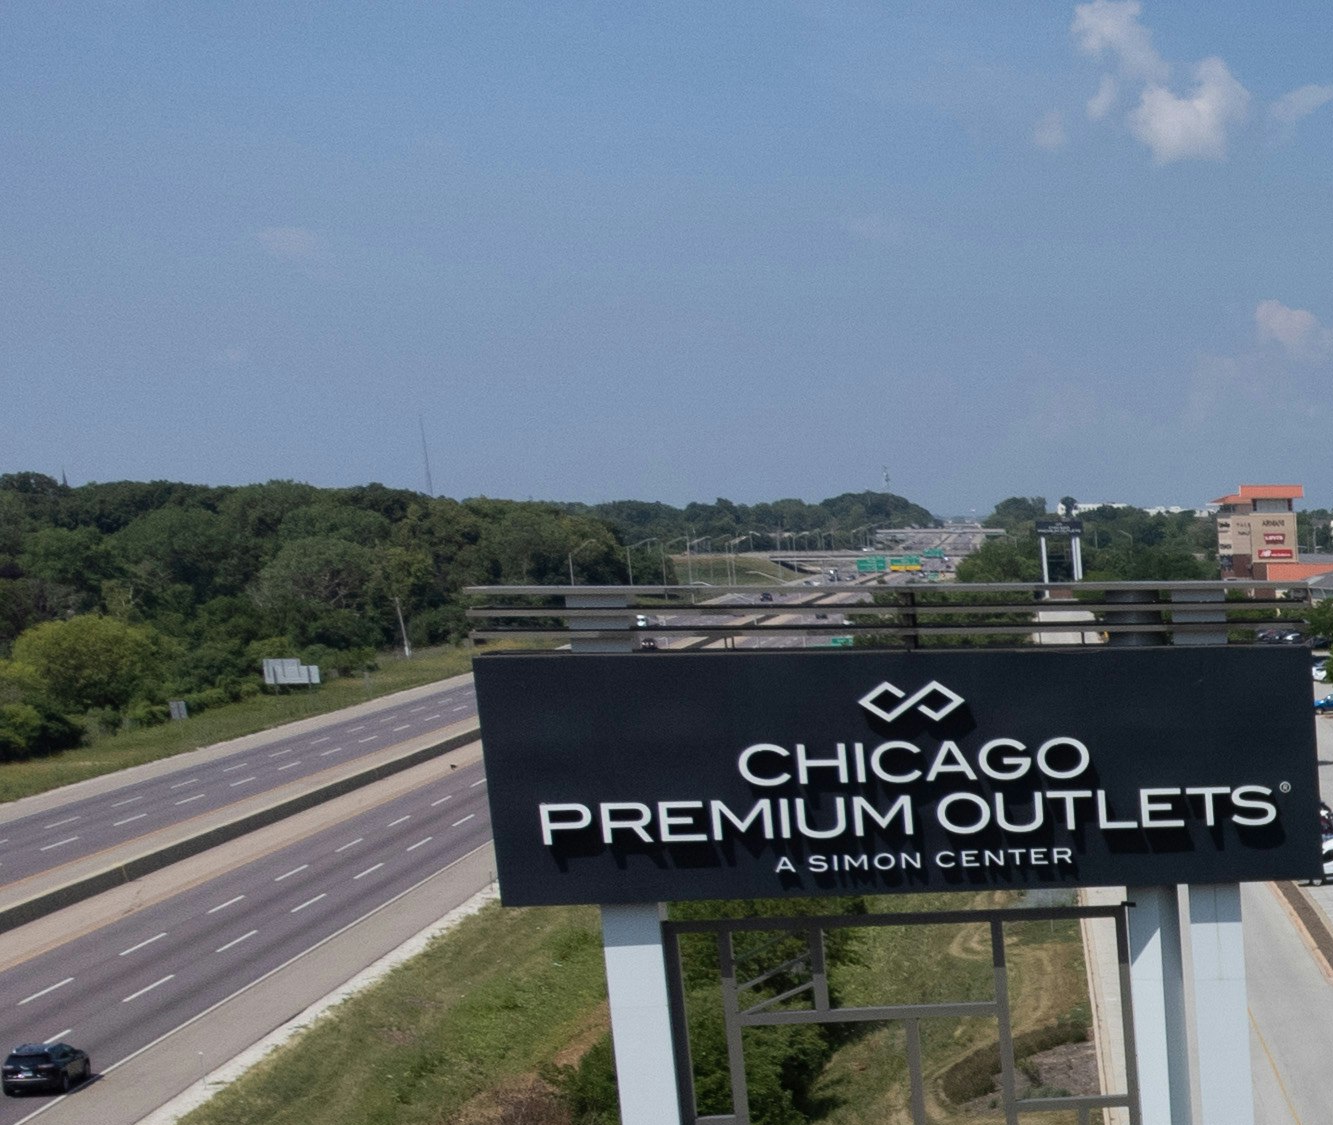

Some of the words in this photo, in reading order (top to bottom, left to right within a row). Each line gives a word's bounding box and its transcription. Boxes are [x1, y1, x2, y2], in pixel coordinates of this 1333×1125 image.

[737, 737, 1090, 787] CHICAGO
[539, 795, 913, 846] PREMIUM
[775, 856, 796, 873] A
[808, 852, 922, 873] SIMON
[935, 847, 1074, 868] CENTER
